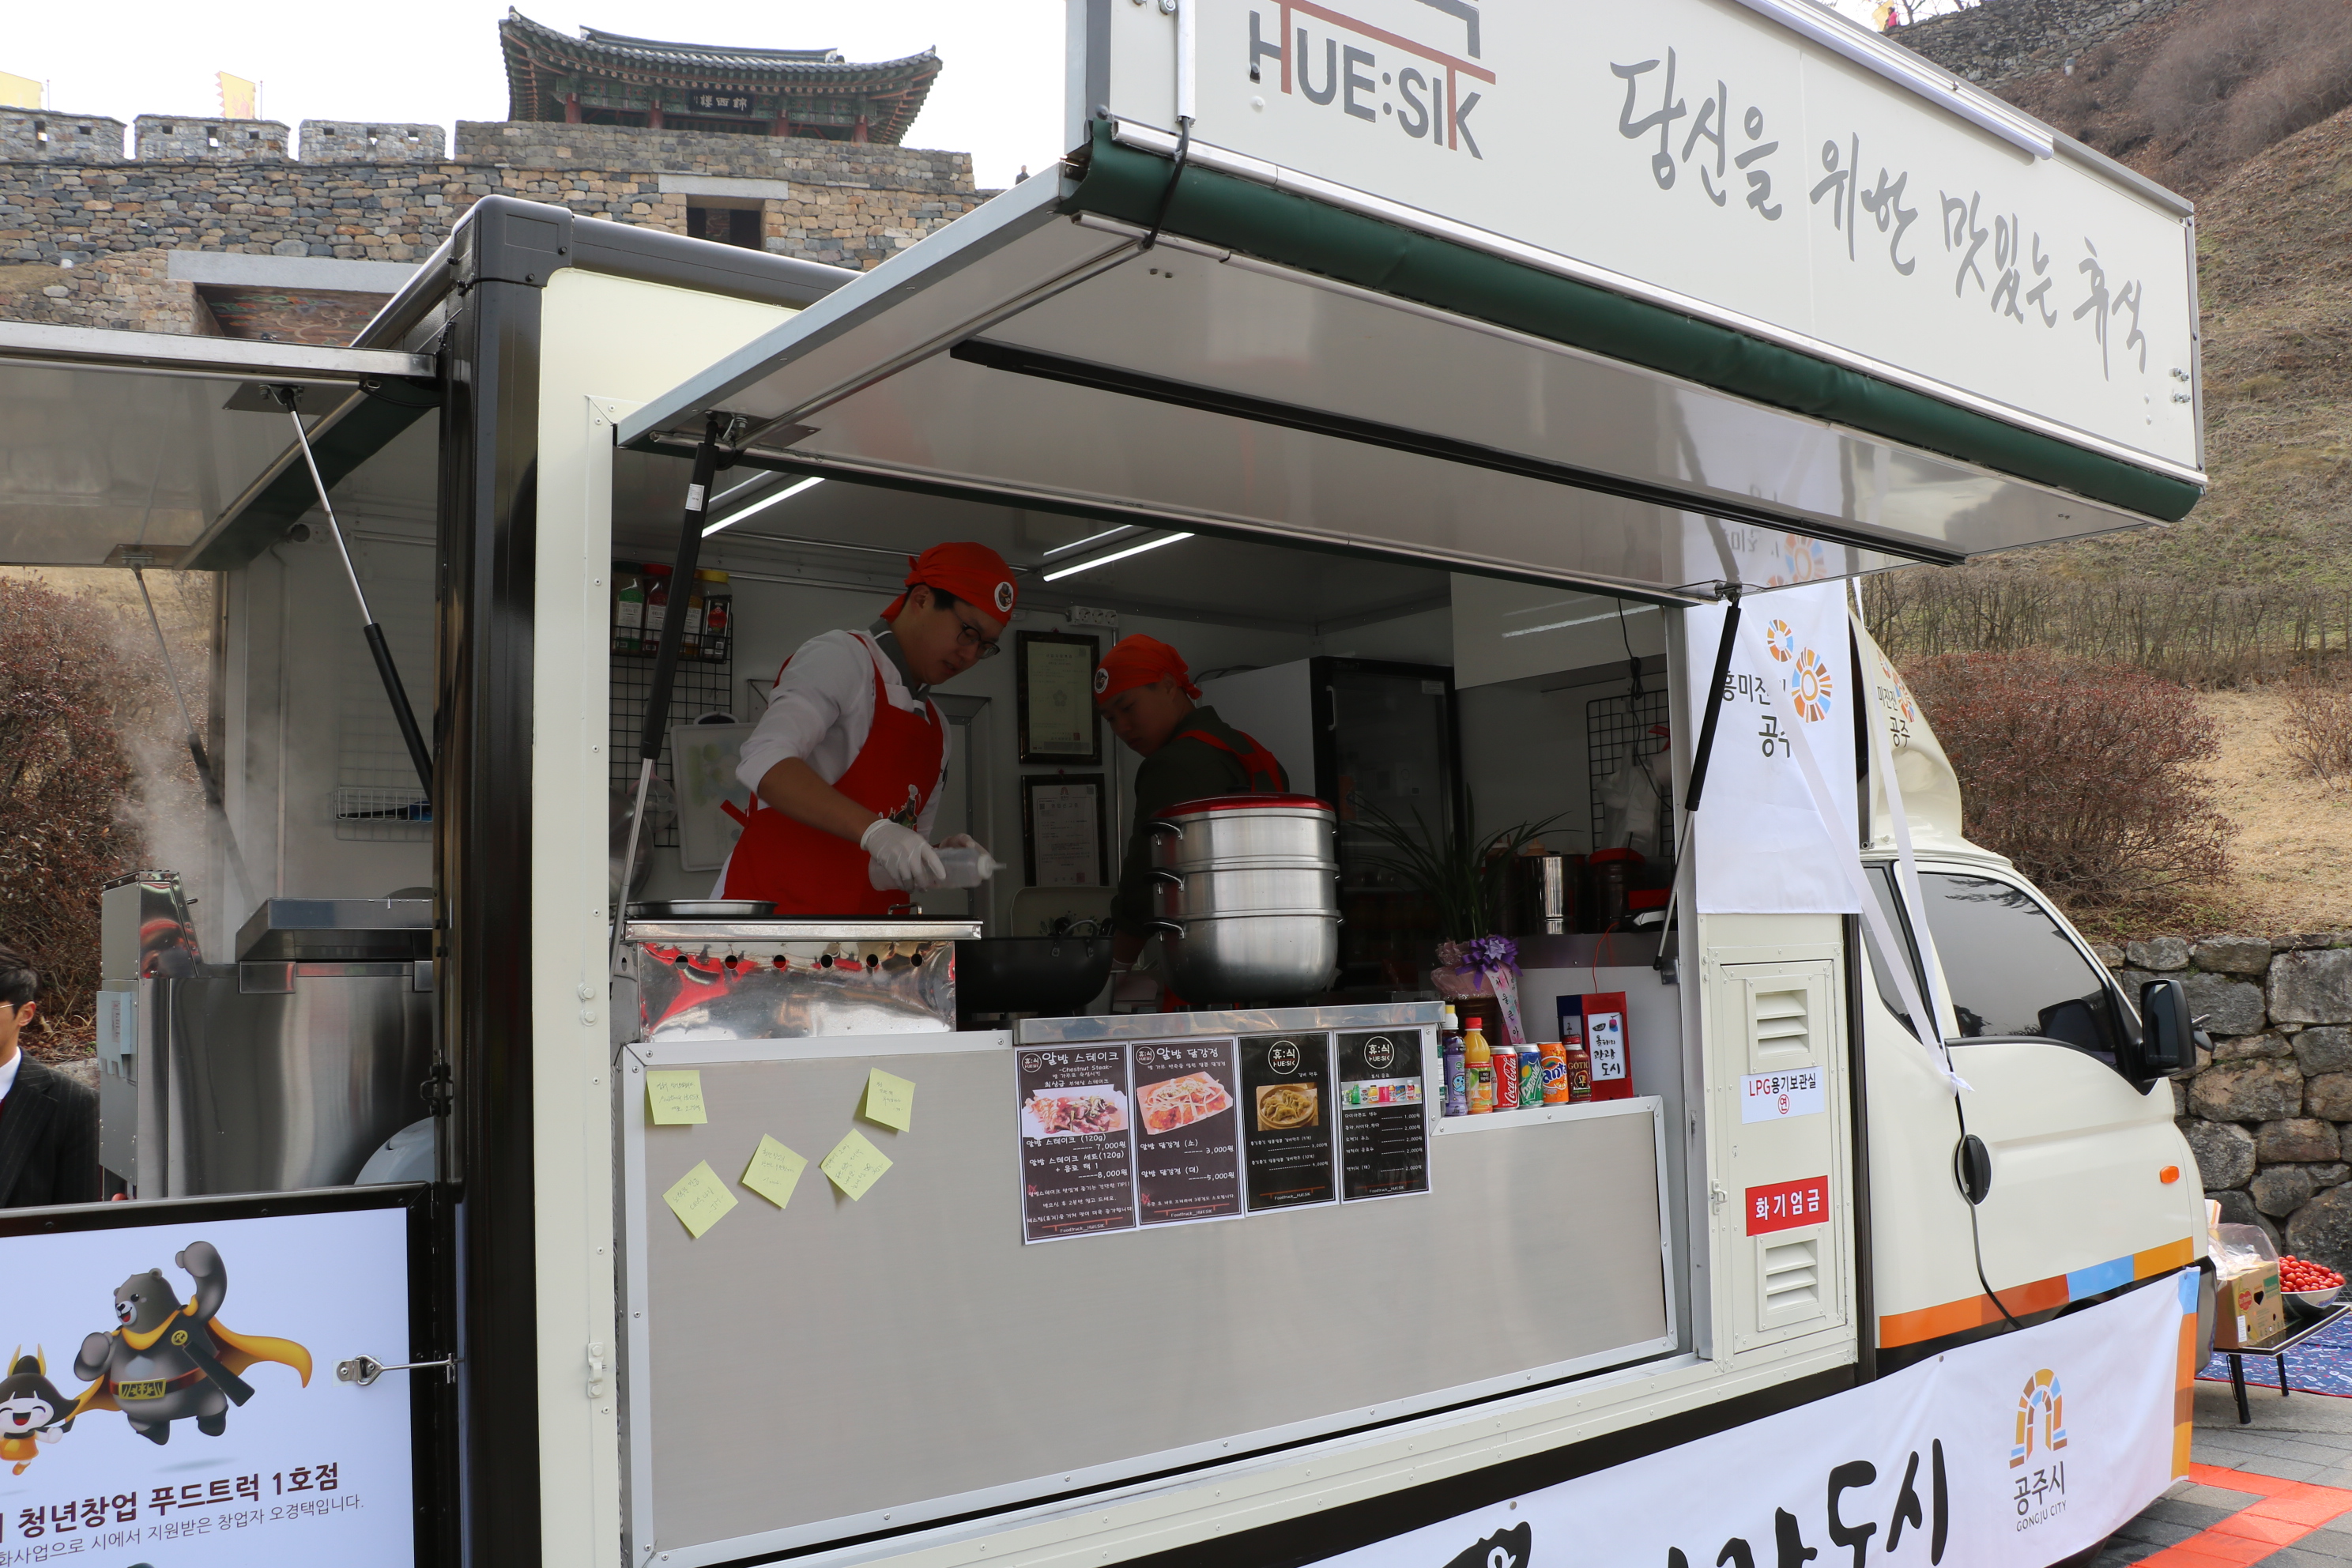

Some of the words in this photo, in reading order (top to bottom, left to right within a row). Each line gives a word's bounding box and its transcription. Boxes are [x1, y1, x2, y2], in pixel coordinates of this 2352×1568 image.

[1610, 46, 1782, 221] 당신을
[1810, 132, 1917, 276] 위한
[1939, 190, 2057, 327] 맛있는
[2073, 237, 2147, 381] 휴식
[1889, 715, 1911, 748] 공주
[1042, 1051, 1069, 1066] 알밤
[1075, 1051, 1119, 1063] 스테이크
[1156, 1046, 1182, 1061] 알밤
[1186, 1047, 1219, 1059] 닭강정
[1593, 1048, 1616, 1061] 관광
[1601, 1062, 1621, 1076] 도시
[1044, 1080, 1065, 1088] 최상급
[1026, 1139, 1042, 1148] 알밤
[1046, 1136, 1076, 1146] 스테이크
[1080, 1133, 1106, 1144] (120g)
[1140, 1142, 1155, 1151] 알밤
[1029, 1158, 1046, 1167] 알밤
[1049, 1155, 1080, 1165] 스테이크
[1140, 1169, 1156, 1178] 알밤
[2013, 1460, 2065, 1517] 공주시
[17, 1491, 138, 1539] 청년창업
[149, 1473, 259, 1516] 푸드트럭
[273, 1461, 339, 1497] 1호점
[91, 1528, 141, 1551] 시에서
[148, 1516, 213, 1543] 지원받은
[217, 1509, 265, 1535] 창업자
[270, 1493, 364, 1524] 오경택입니다.
[2016, 1508, 2049, 1532] GONGJU
[2049, 1499, 2067, 1517] CITY
